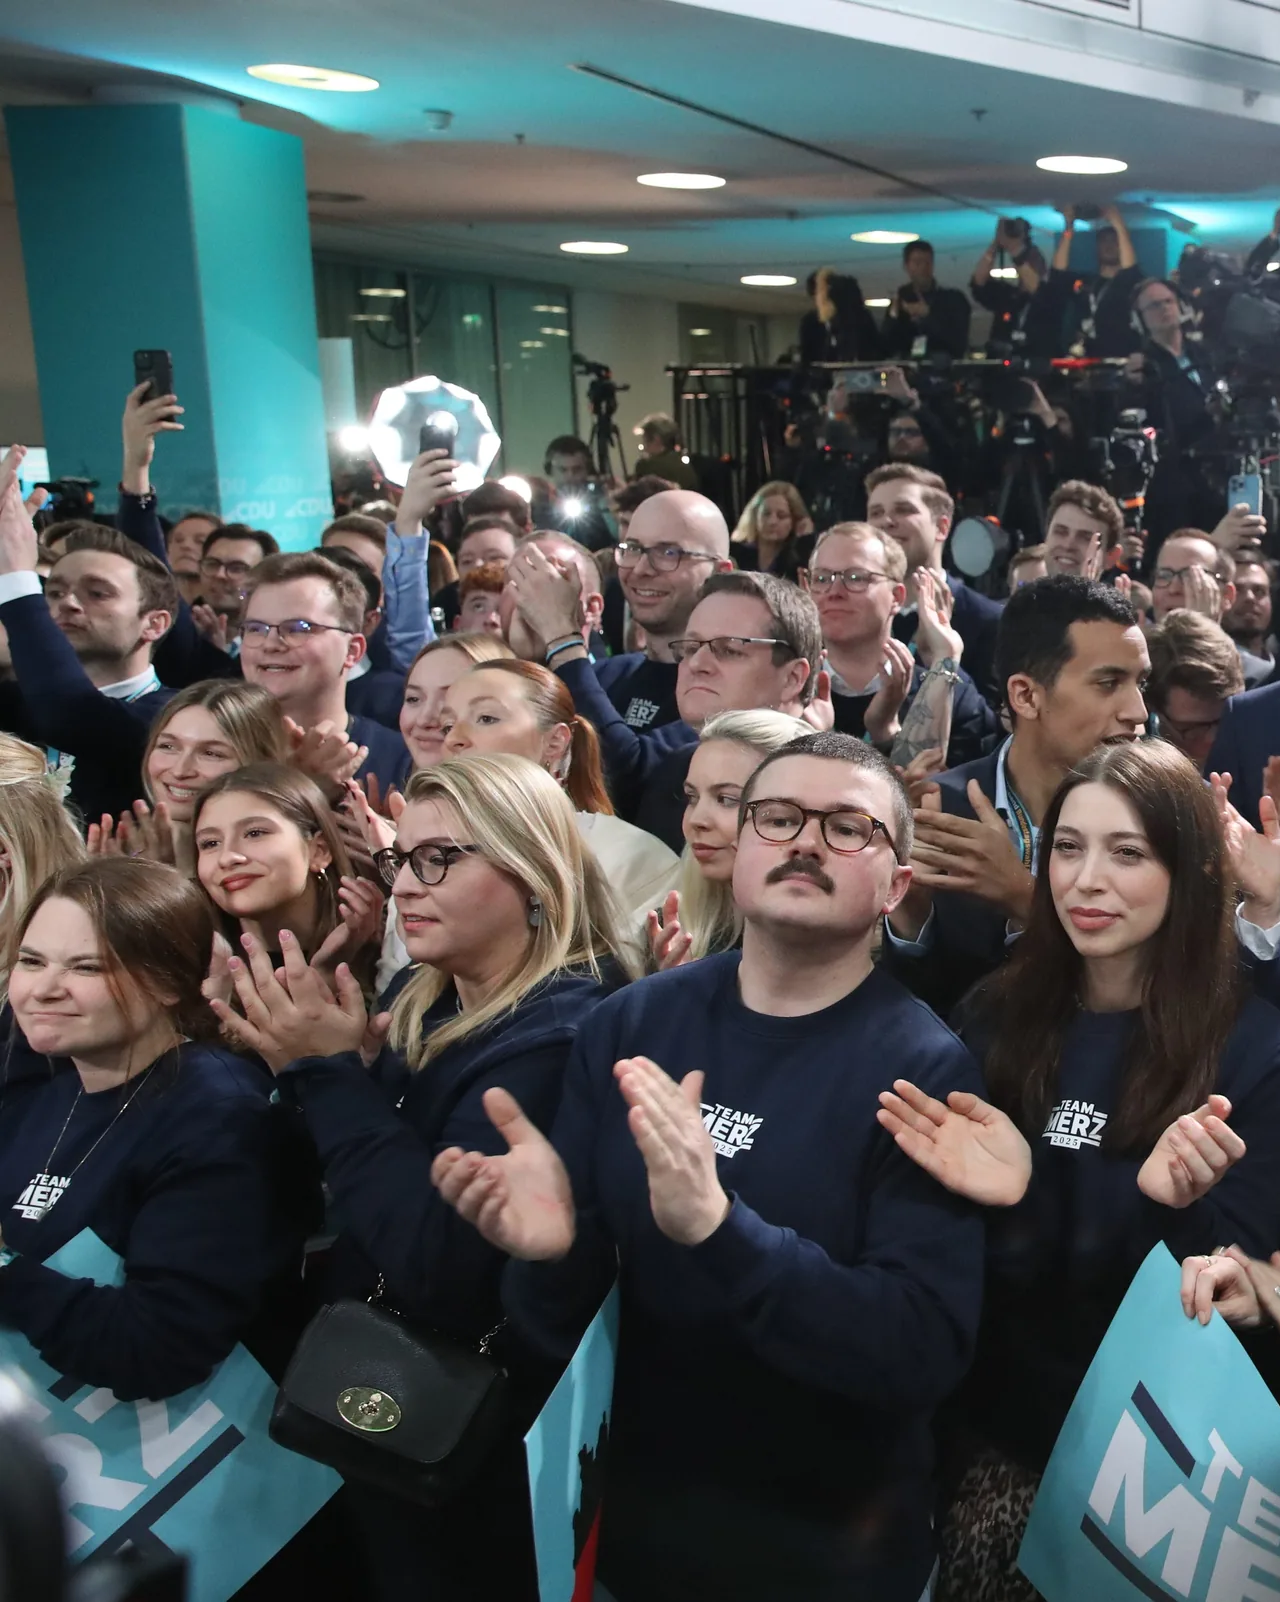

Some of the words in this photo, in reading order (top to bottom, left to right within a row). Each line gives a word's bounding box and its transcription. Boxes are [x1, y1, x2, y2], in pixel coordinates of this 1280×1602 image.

[236, 502, 276, 519] CDU
[714, 1103, 755, 1125] TEAM
[1060, 1100, 1095, 1116] TEAM
[1044, 1111, 1107, 1141] MERZ
[1053, 1136, 1078, 1147] 2025
[33, 1173, 72, 1188] TEAM
